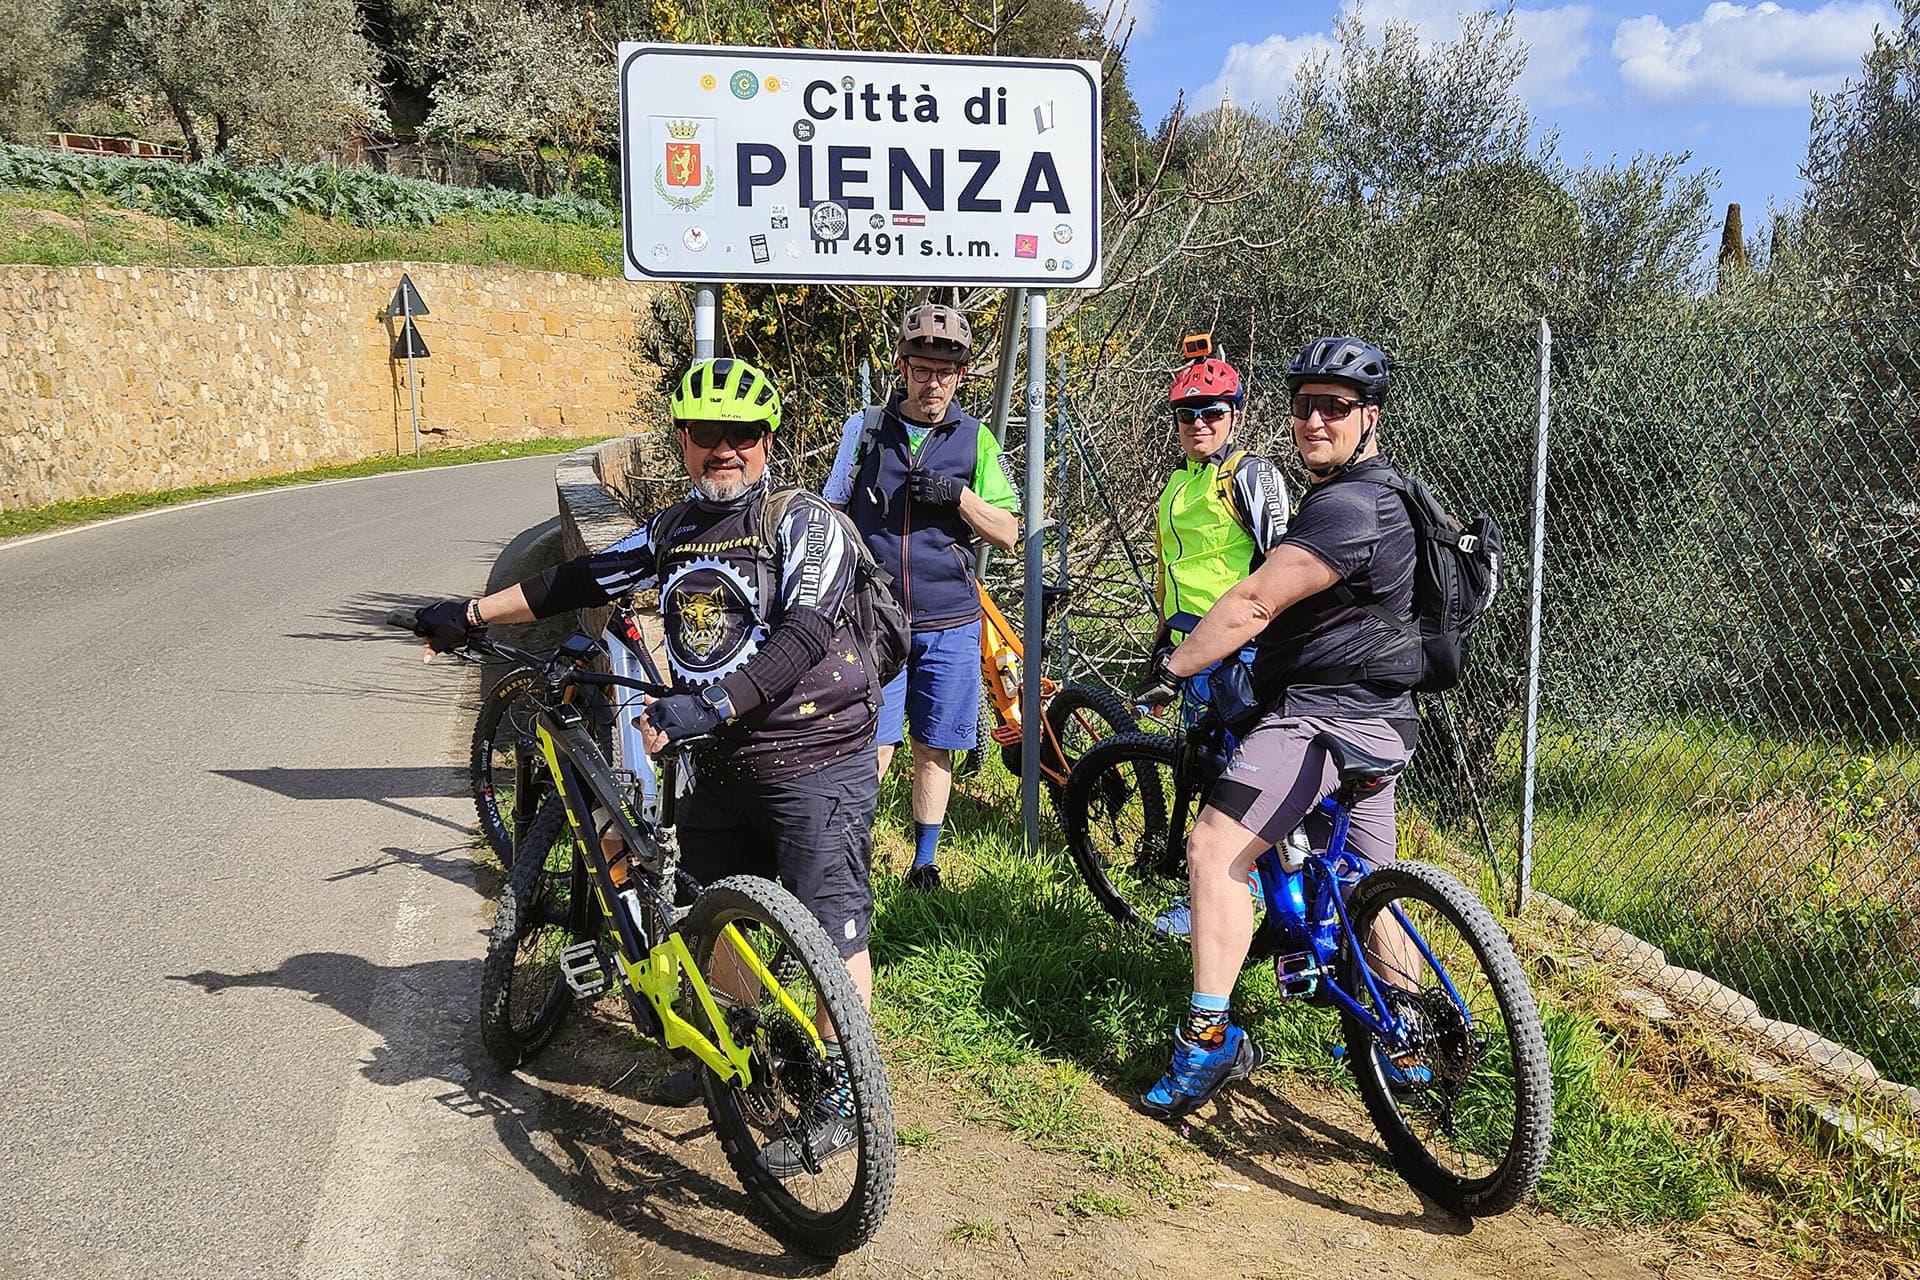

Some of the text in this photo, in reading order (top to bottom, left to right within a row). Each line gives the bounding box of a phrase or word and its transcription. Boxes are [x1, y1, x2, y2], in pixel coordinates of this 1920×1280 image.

[804, 79, 940, 124] Città
[965, 86, 1007, 126] di
[737, 143, 1071, 214] PIENZA
[814, 233, 999, 257] m 491 s.l.m.
[798, 522, 825, 608] MTLABDESIGN
[499, 677, 534, 699] MAXXIS
